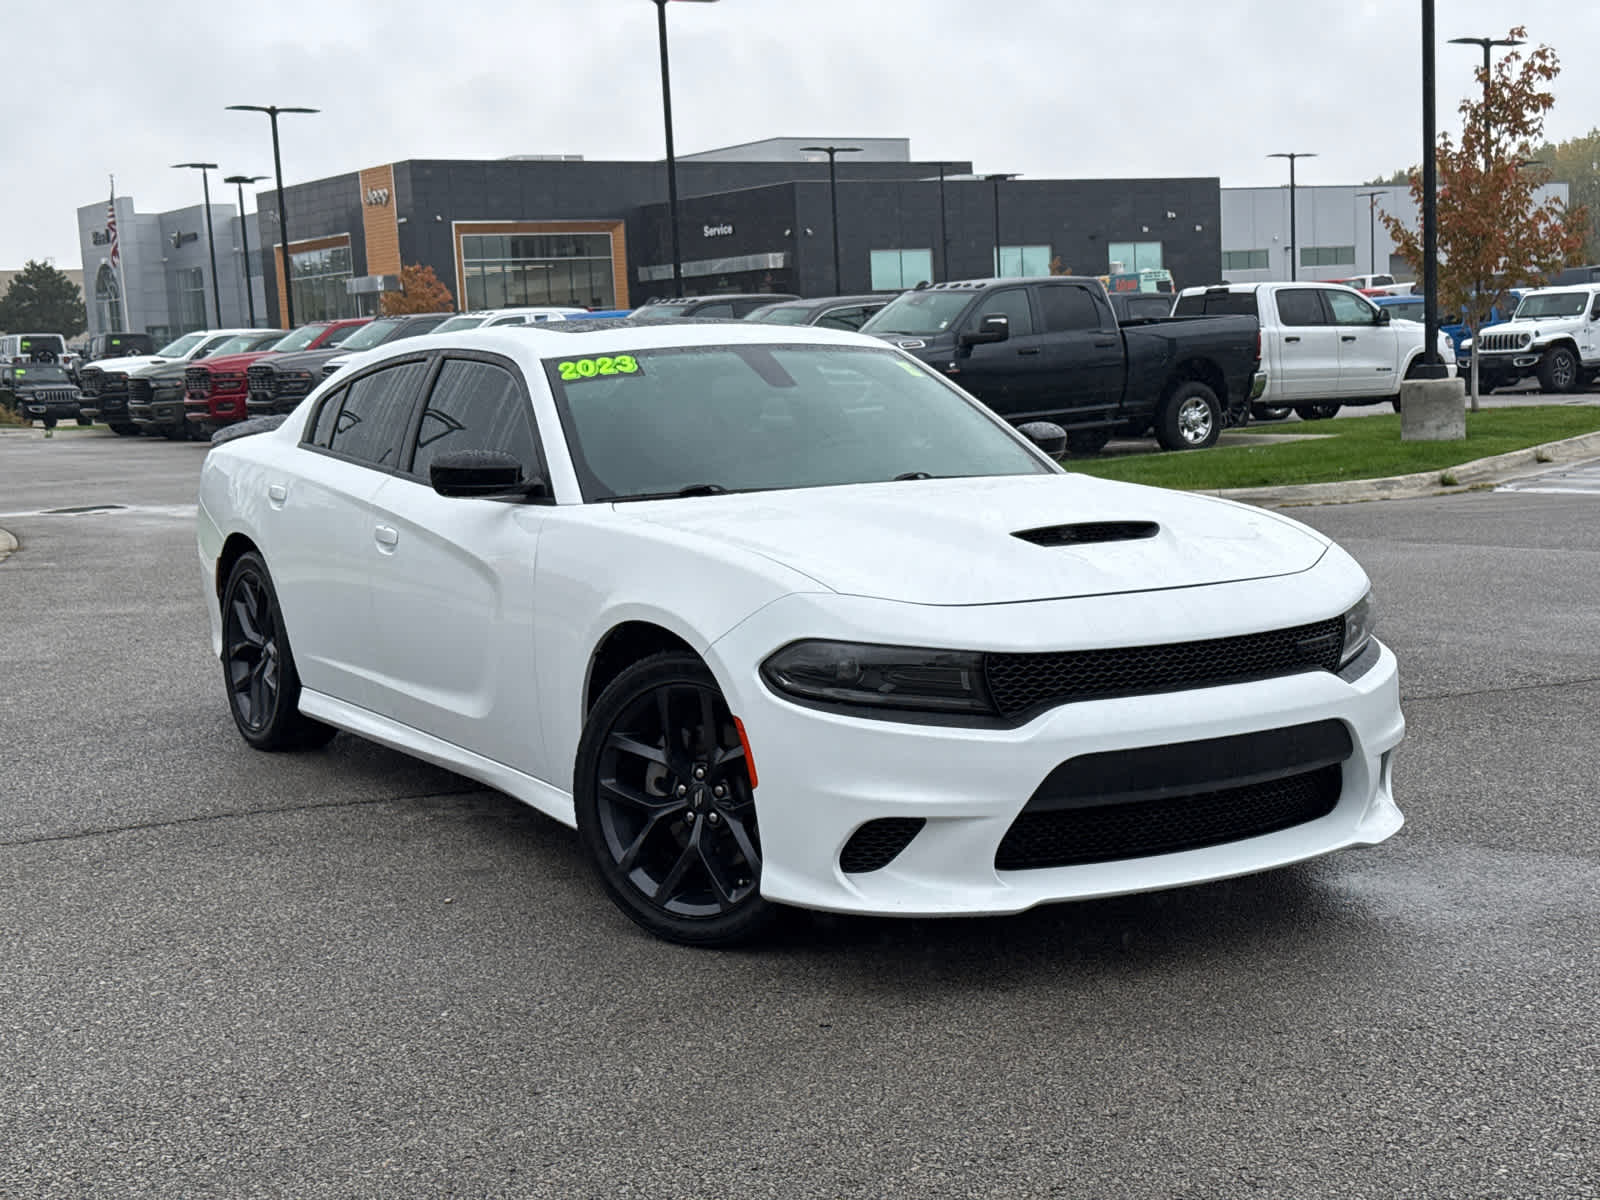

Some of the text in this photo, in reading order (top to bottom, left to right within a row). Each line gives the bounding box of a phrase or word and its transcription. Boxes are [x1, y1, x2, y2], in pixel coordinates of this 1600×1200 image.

[366, 187, 389, 206] Jeep
[703, 223, 733, 238] Service
[558, 354, 639, 381] 2023
